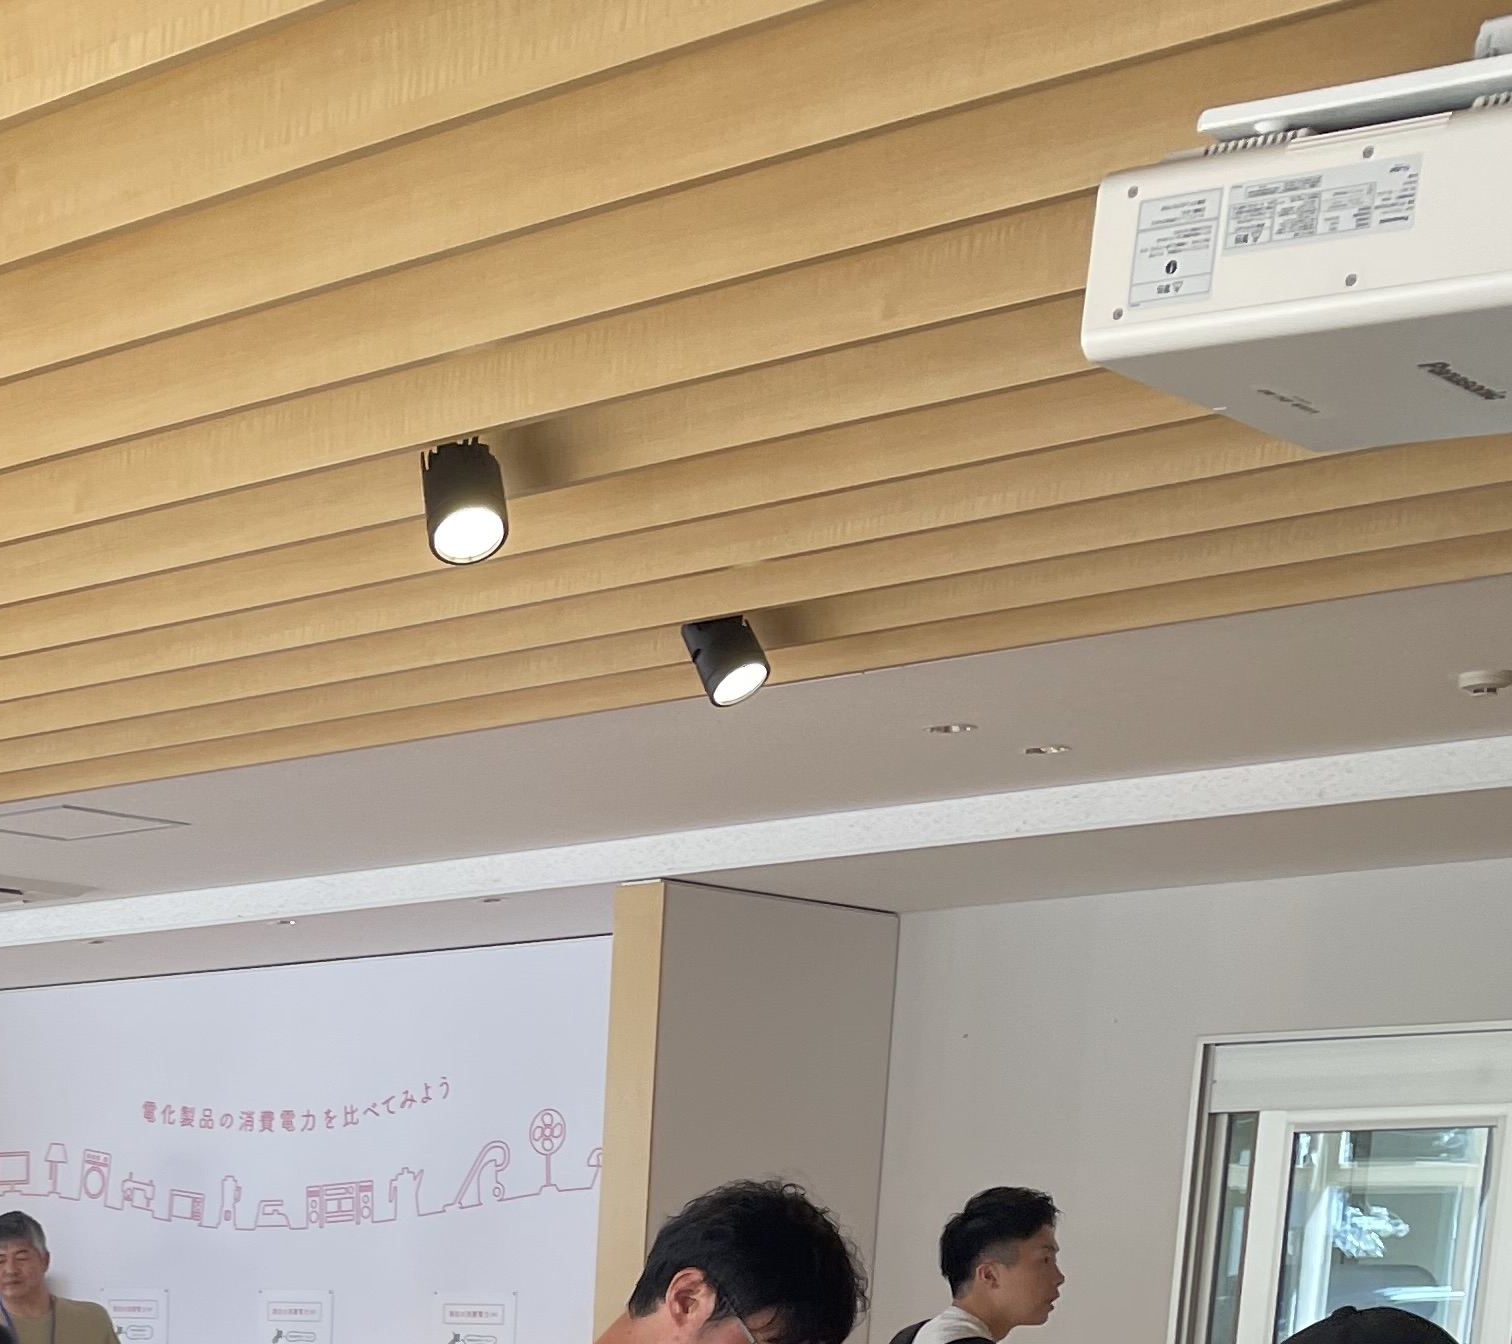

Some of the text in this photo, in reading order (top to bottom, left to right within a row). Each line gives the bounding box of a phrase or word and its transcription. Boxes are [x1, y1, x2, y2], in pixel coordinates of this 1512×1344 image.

[142, 1076, 450, 1132] 電化製品の消費電力を比べてみよう
